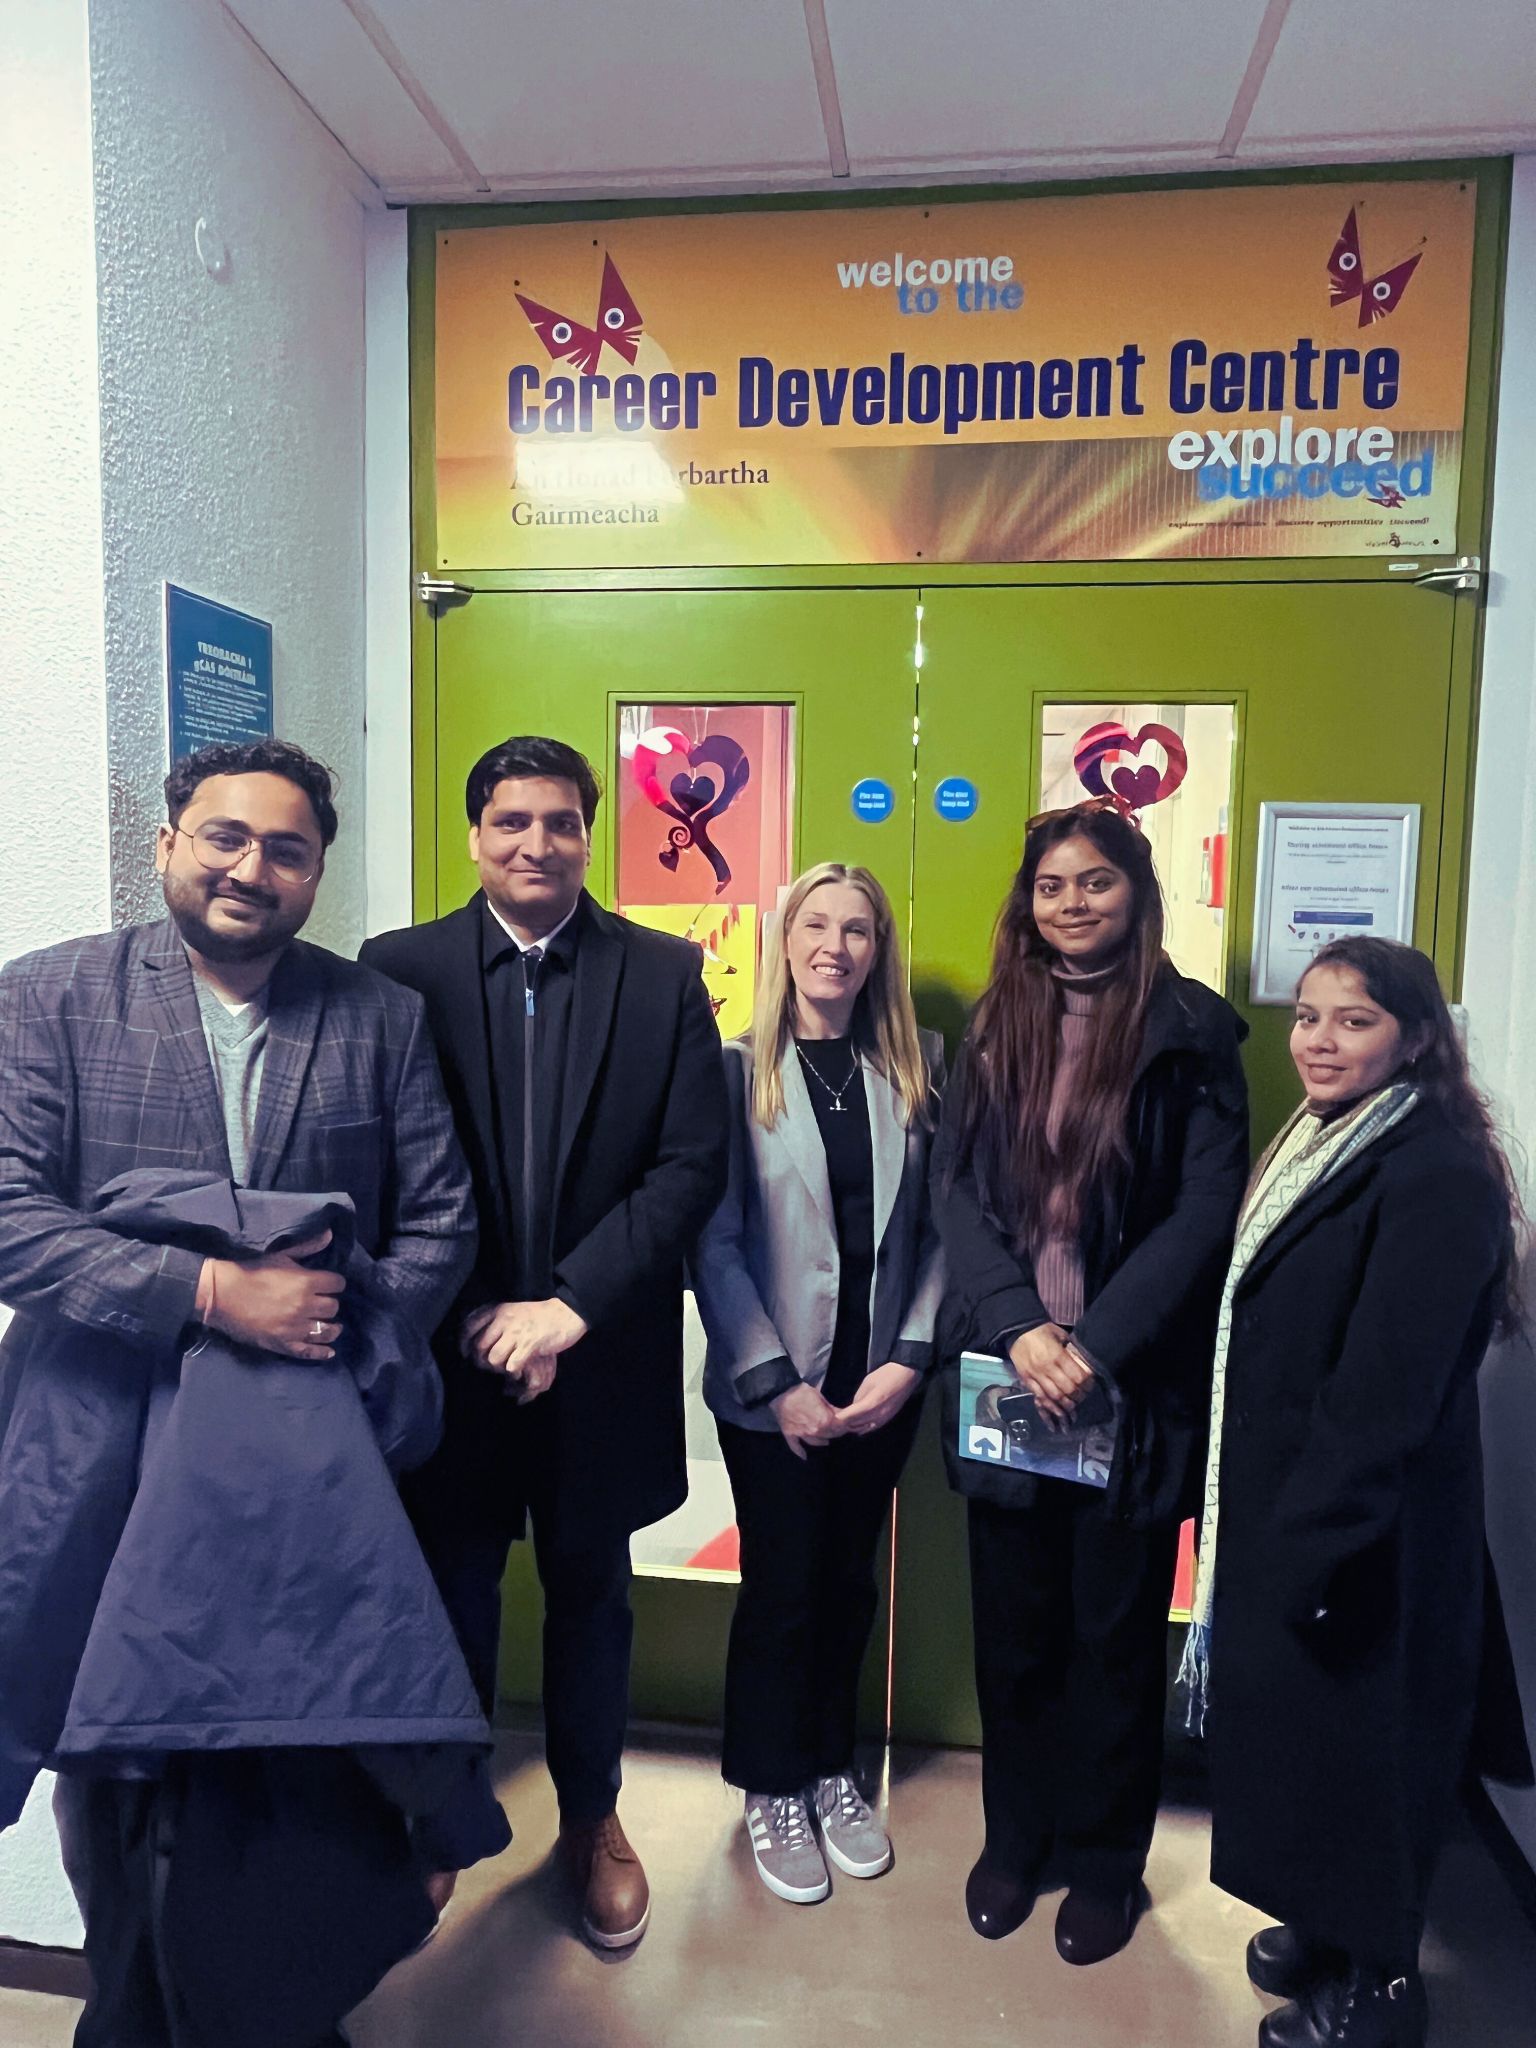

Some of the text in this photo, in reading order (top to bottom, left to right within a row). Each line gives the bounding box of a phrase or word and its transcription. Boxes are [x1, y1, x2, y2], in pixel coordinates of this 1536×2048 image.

[837, 252, 1013, 288] welcome
[898, 279, 1025, 315] to the
[508, 338, 1399, 434] Career Development Centre
[1168, 416, 1394, 480] explore
[1197, 448, 1435, 502] succeed
[511, 502, 660, 526] Gairmeacha
